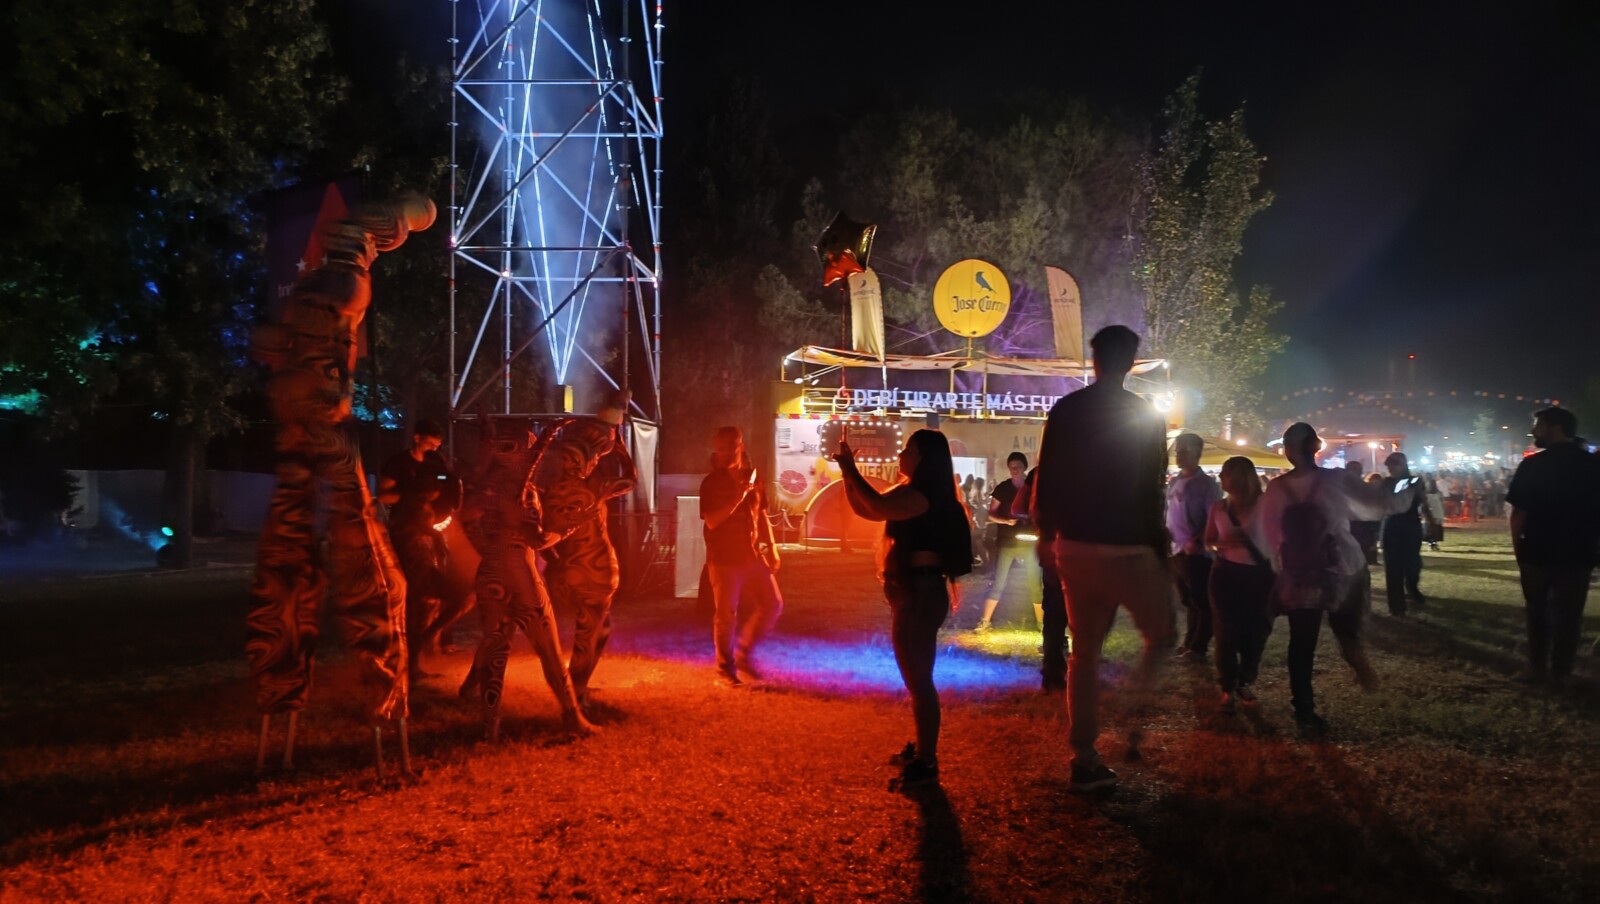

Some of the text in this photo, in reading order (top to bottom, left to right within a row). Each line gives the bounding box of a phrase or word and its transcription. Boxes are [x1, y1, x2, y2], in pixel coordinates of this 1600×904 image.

[952, 295, 977, 313] Jose
[854, 387, 899, 407] DEBÍ
[901, 390, 983, 409] TIRARTE
[986, 391, 1026, 411] MÁS
